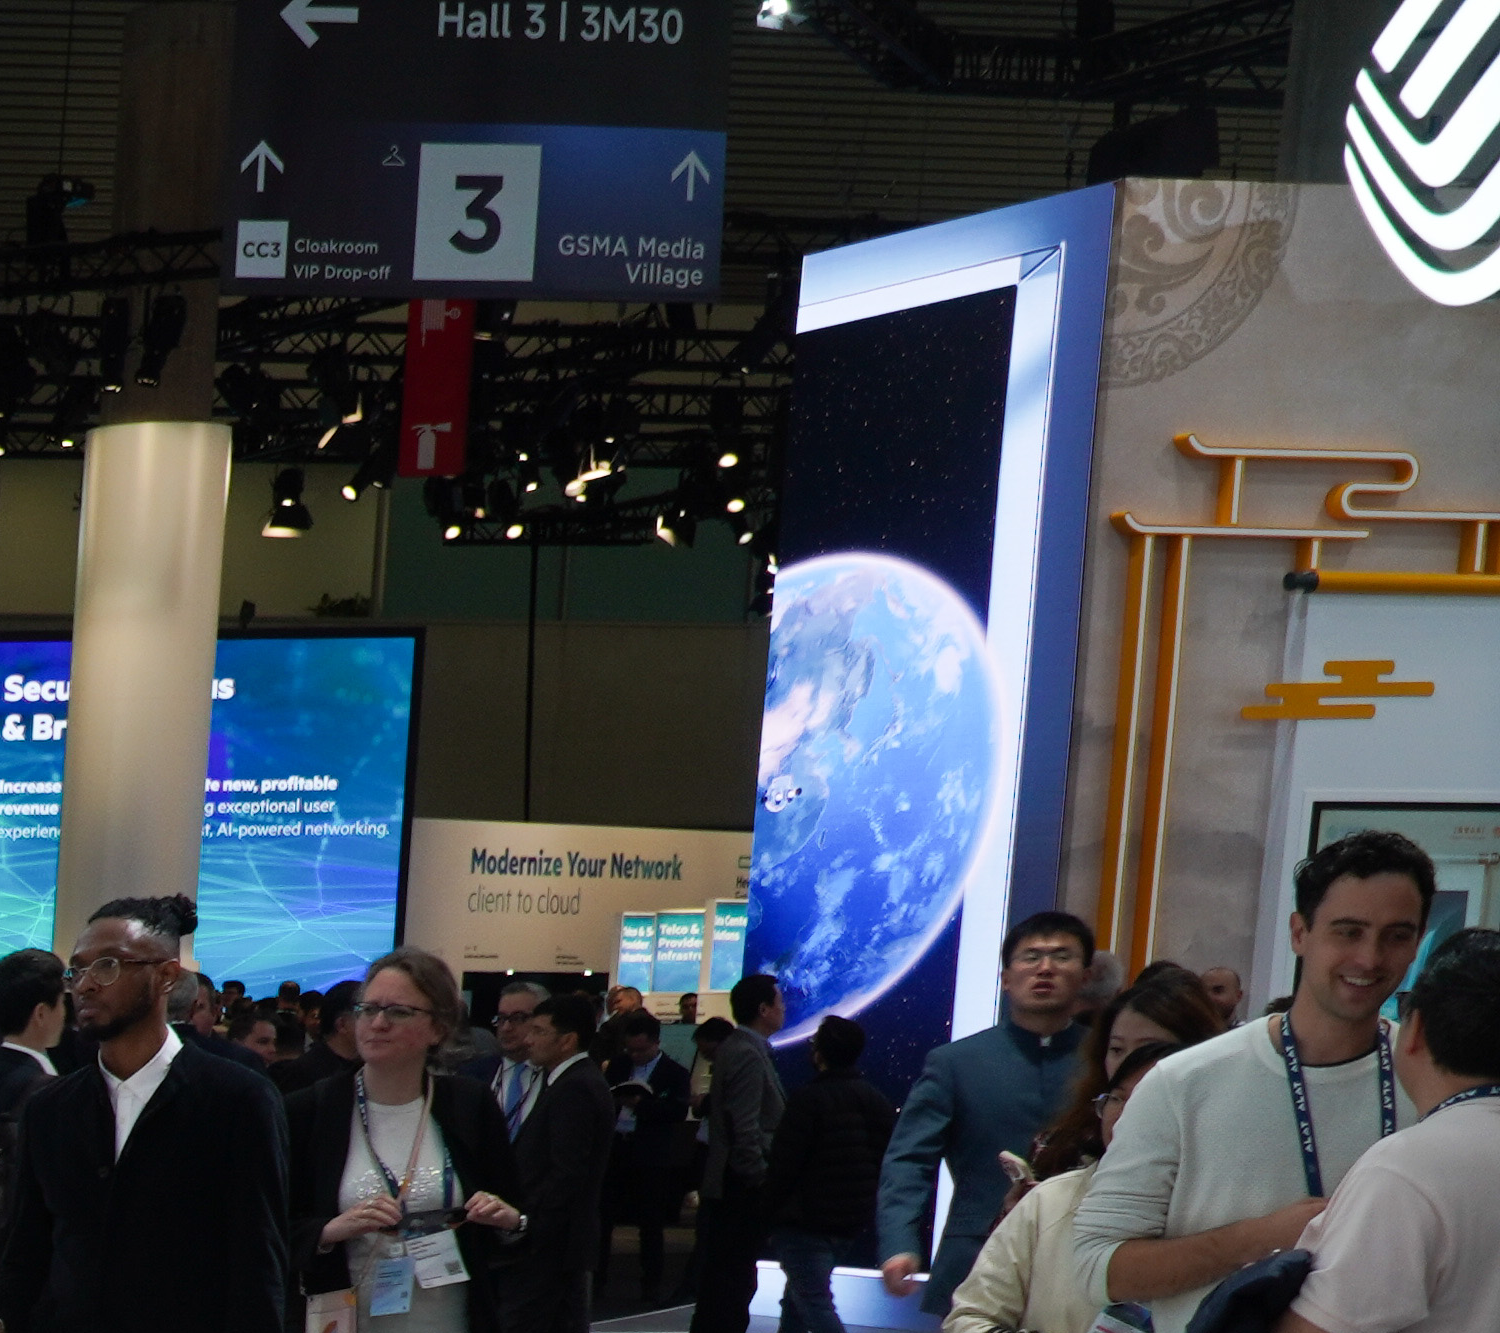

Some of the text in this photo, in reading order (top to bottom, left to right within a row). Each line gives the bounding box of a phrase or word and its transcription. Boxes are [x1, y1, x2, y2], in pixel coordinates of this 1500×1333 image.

[437, 1, 512, 40] Hall
[524, 3, 547, 40] 3
[581, 4, 684, 45] 3M30
[448, 174, 504, 254] 3
[243, 238, 379, 259] CC3 Cloakroom
[557, 235, 705, 260] GSMA Media
[293, 264, 392, 283] VIP Drop-off
[625, 262, 704, 289] Village
[222, 779, 258, 797] new,
[261, 775, 338, 800] profitable
[217, 799, 301, 818] exceptional
[303, 800, 336, 814] user
[216, 822, 302, 840] AI-powered
[470, 847, 683, 881] Modernize Your Network
[467, 885, 581, 915] client to cloud
